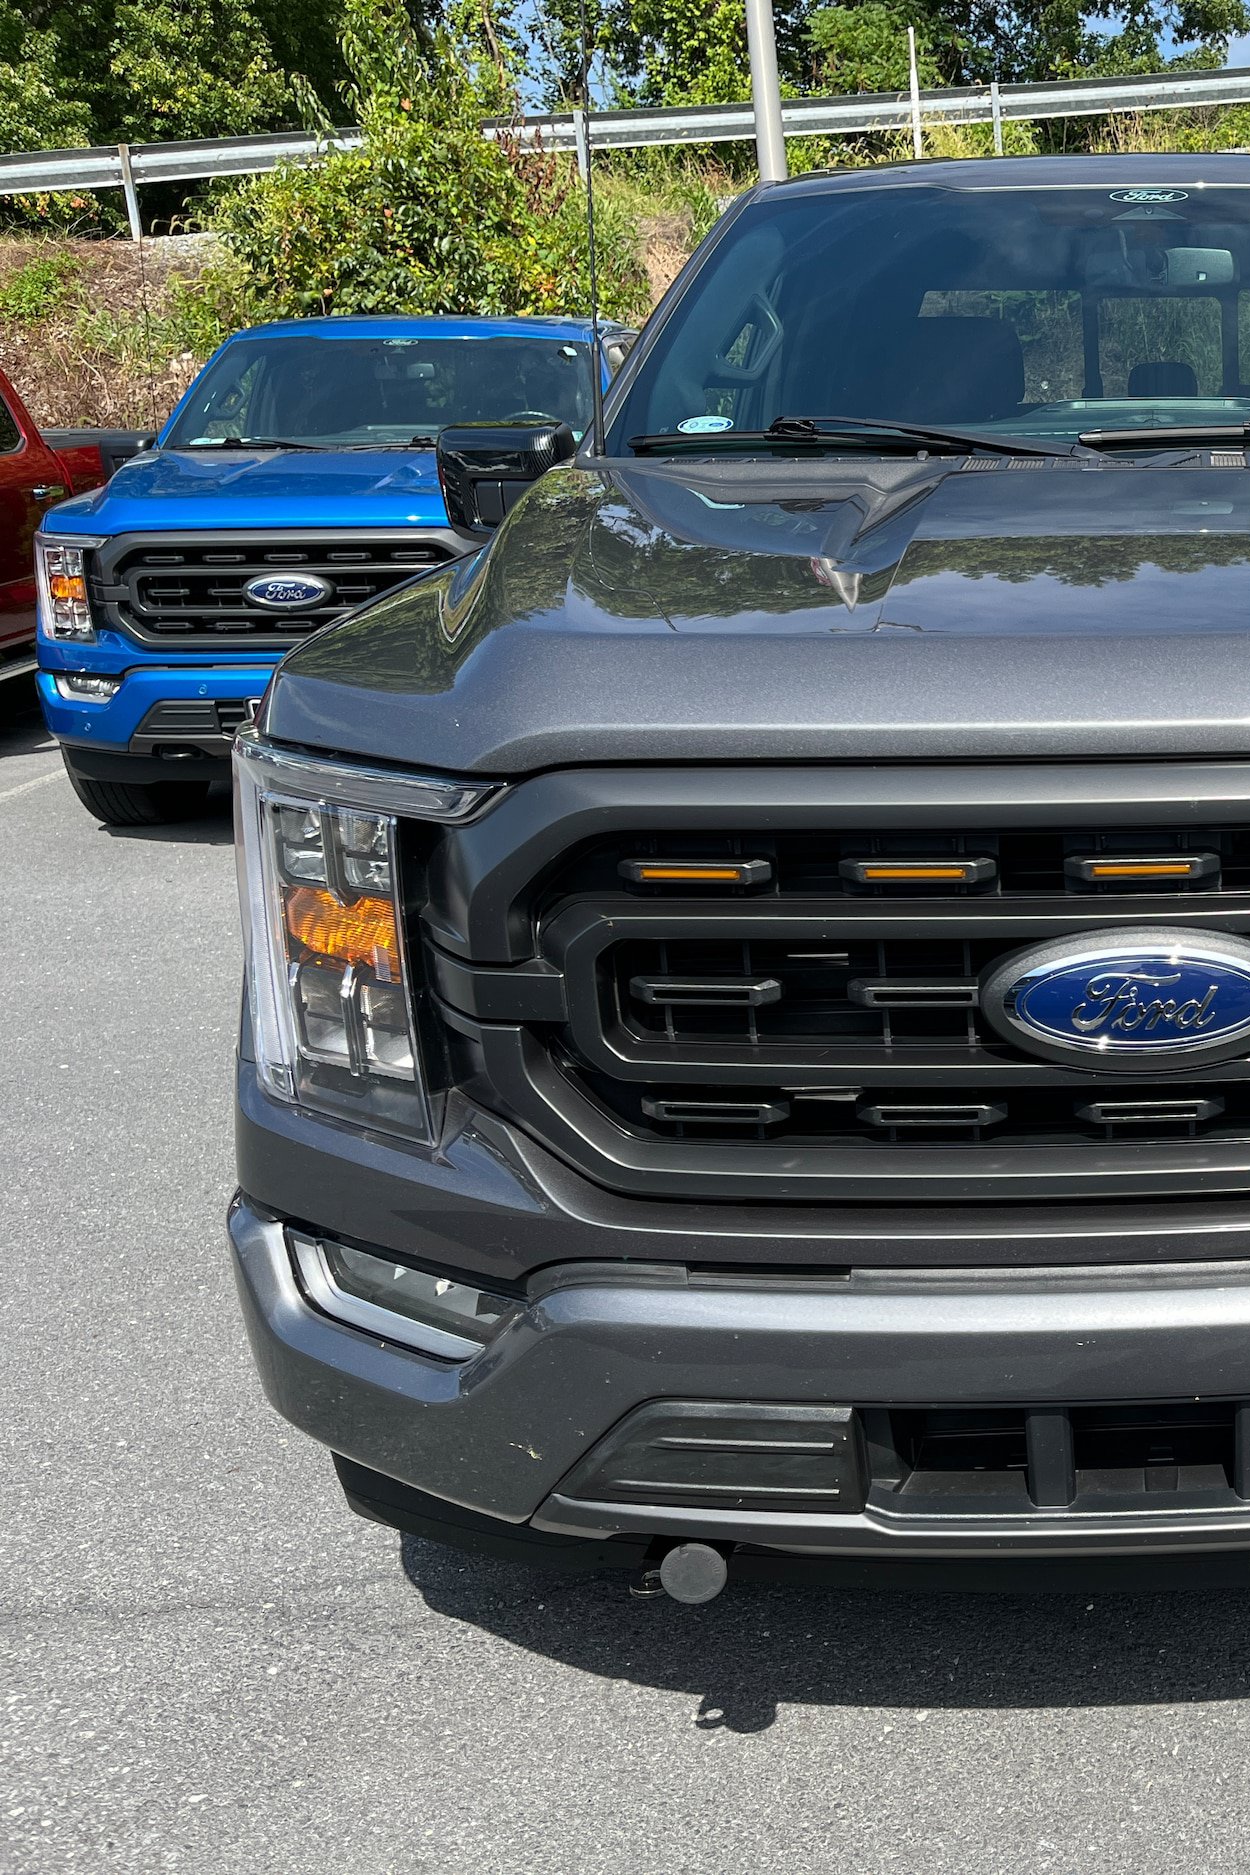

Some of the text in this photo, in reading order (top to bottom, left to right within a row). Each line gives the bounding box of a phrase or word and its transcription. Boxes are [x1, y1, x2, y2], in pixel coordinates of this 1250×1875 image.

[1123, 190, 1175, 201] Ford
[265, 582, 307, 600] Ford
[1071, 972, 1219, 1032] Ford
